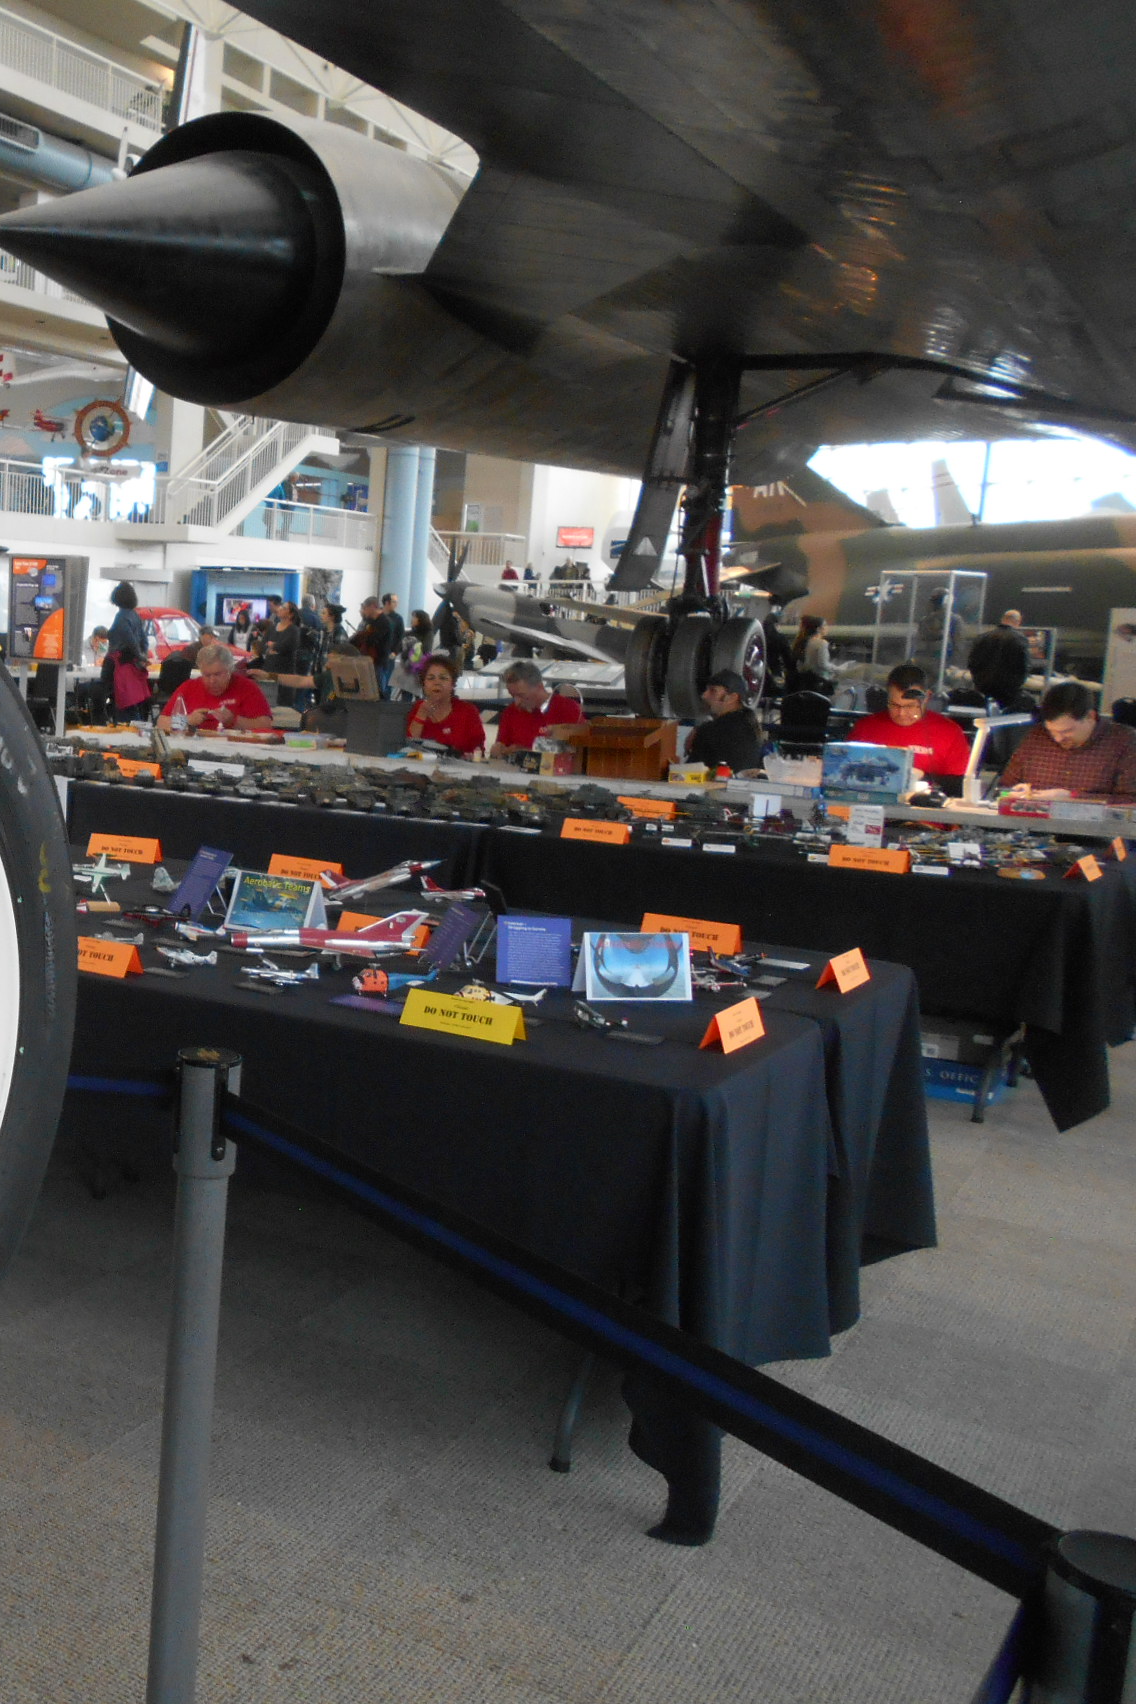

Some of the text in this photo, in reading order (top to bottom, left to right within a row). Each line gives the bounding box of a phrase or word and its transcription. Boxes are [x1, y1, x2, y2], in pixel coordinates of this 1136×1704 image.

[244, 876, 311, 894] Aerobatic Teams
[691, 931, 719, 941] TOUCH
[89, 950, 114, 962] TOUCH
[424, 1005, 437, 1015] DO
[439, 1008, 460, 1019] NOT
[461, 1012, 494, 1026] TOUCH
[939, 1069, 980, 1084] OFFIC
